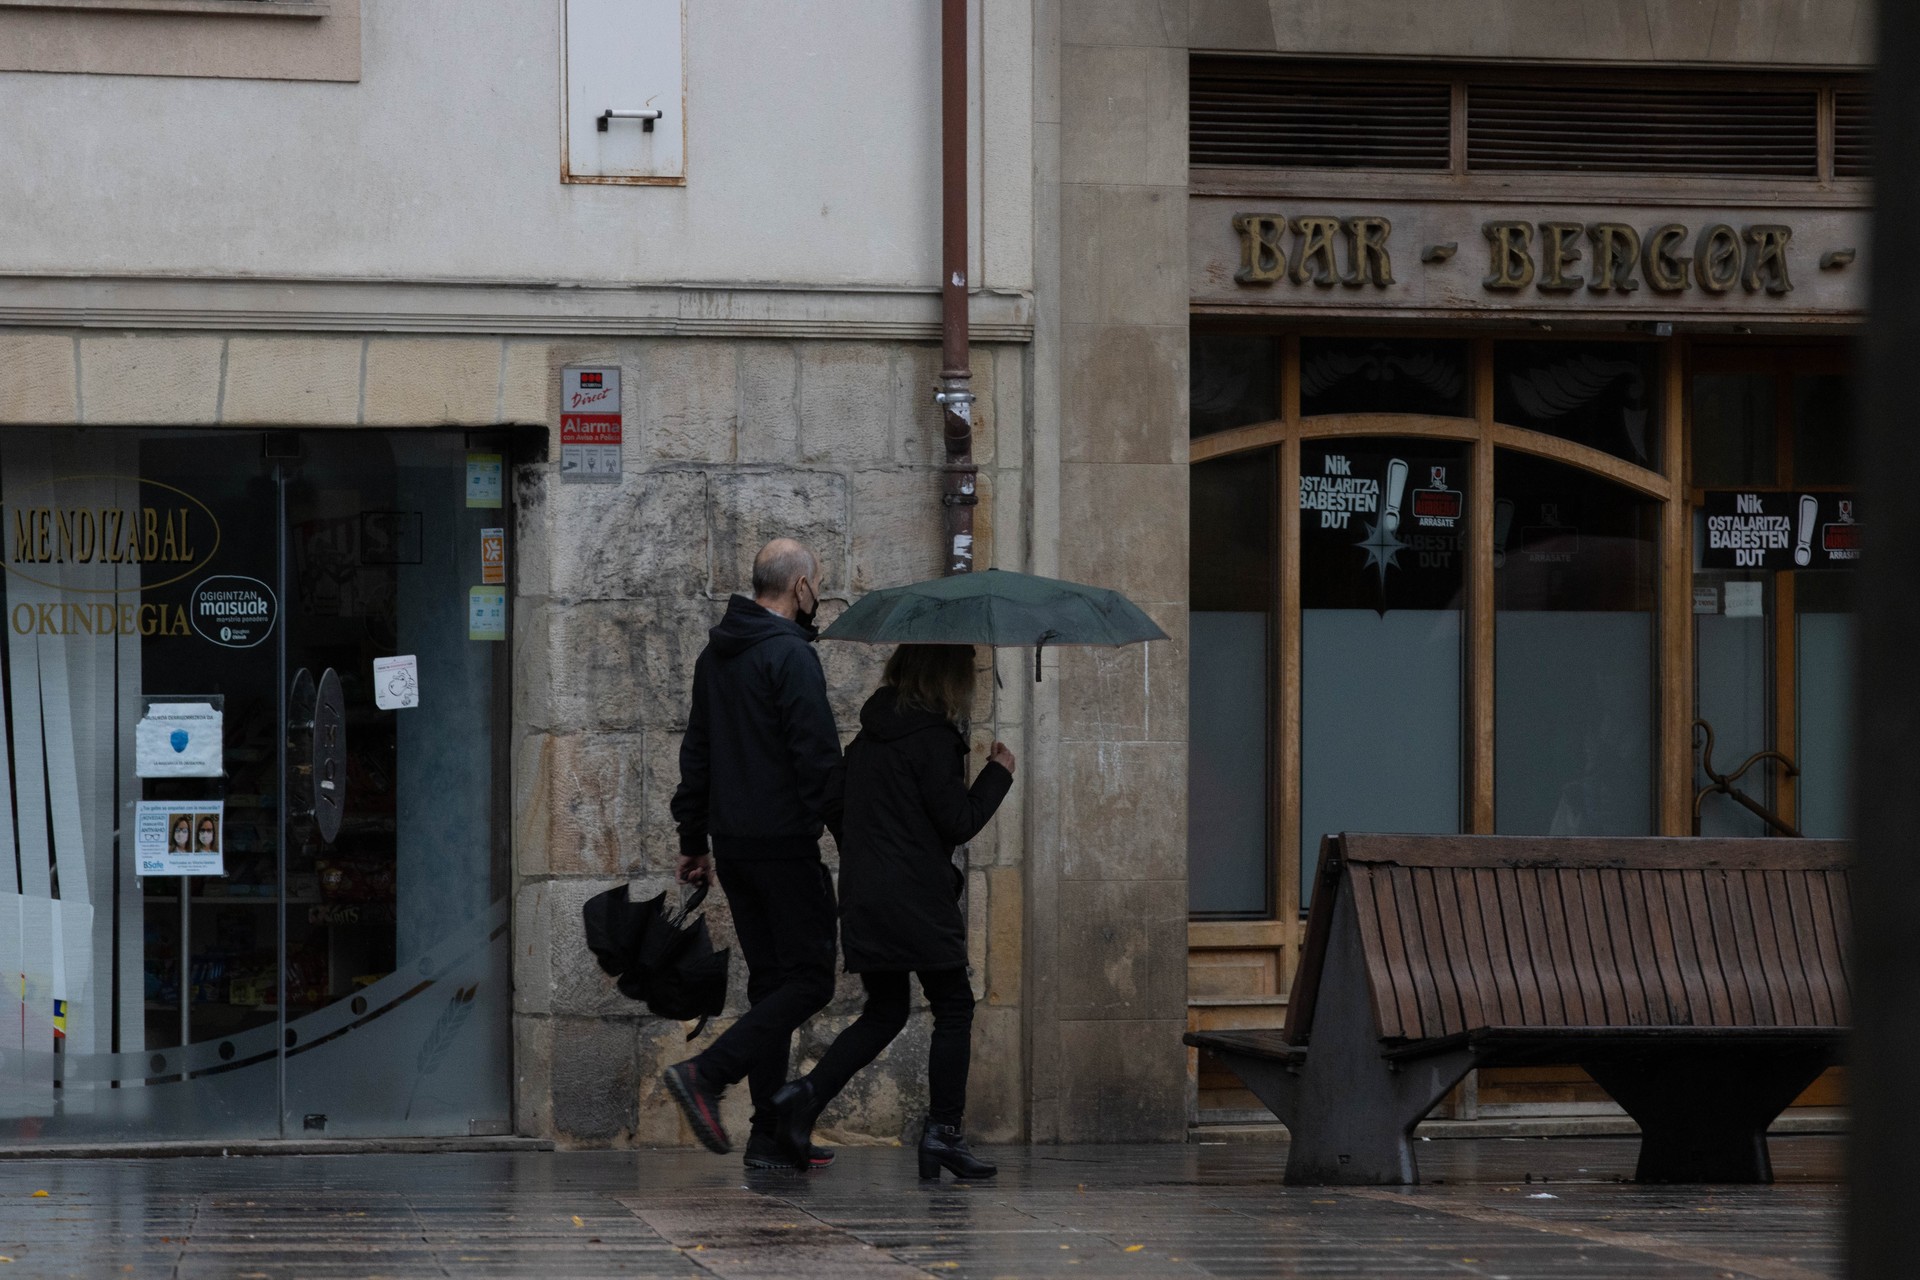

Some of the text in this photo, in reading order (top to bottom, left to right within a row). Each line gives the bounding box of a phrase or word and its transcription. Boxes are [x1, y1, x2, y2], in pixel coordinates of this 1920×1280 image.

[1233, 213, 1396, 287] BAR
[1482, 220, 1794, 296] BENGOA
[571, 388, 612, 408] Direct
[563, 418, 620, 433] Alarma
[1325, 455, 1351, 475] Nik
[1300, 491, 1377, 512] BABESTEN
[1736, 494, 1763, 514] Nik
[1321, 511, 1351, 529] DUT
[1419, 517, 1455, 527] ARRASATE
[1708, 516, 1791, 531] OSTALARITZA
[14, 506, 196, 564] MENDIZABAL
[1710, 530, 1789, 549] BABESTEN
[1418, 551, 1452, 569] DUT
[1735, 549, 1766, 567] DUT
[200, 591, 257, 601] OGIGINTZAN
[200, 596, 268, 615] maisuak
[12, 602, 193, 638] OKINDEGIA
[143, 860, 164, 869] BSafe
